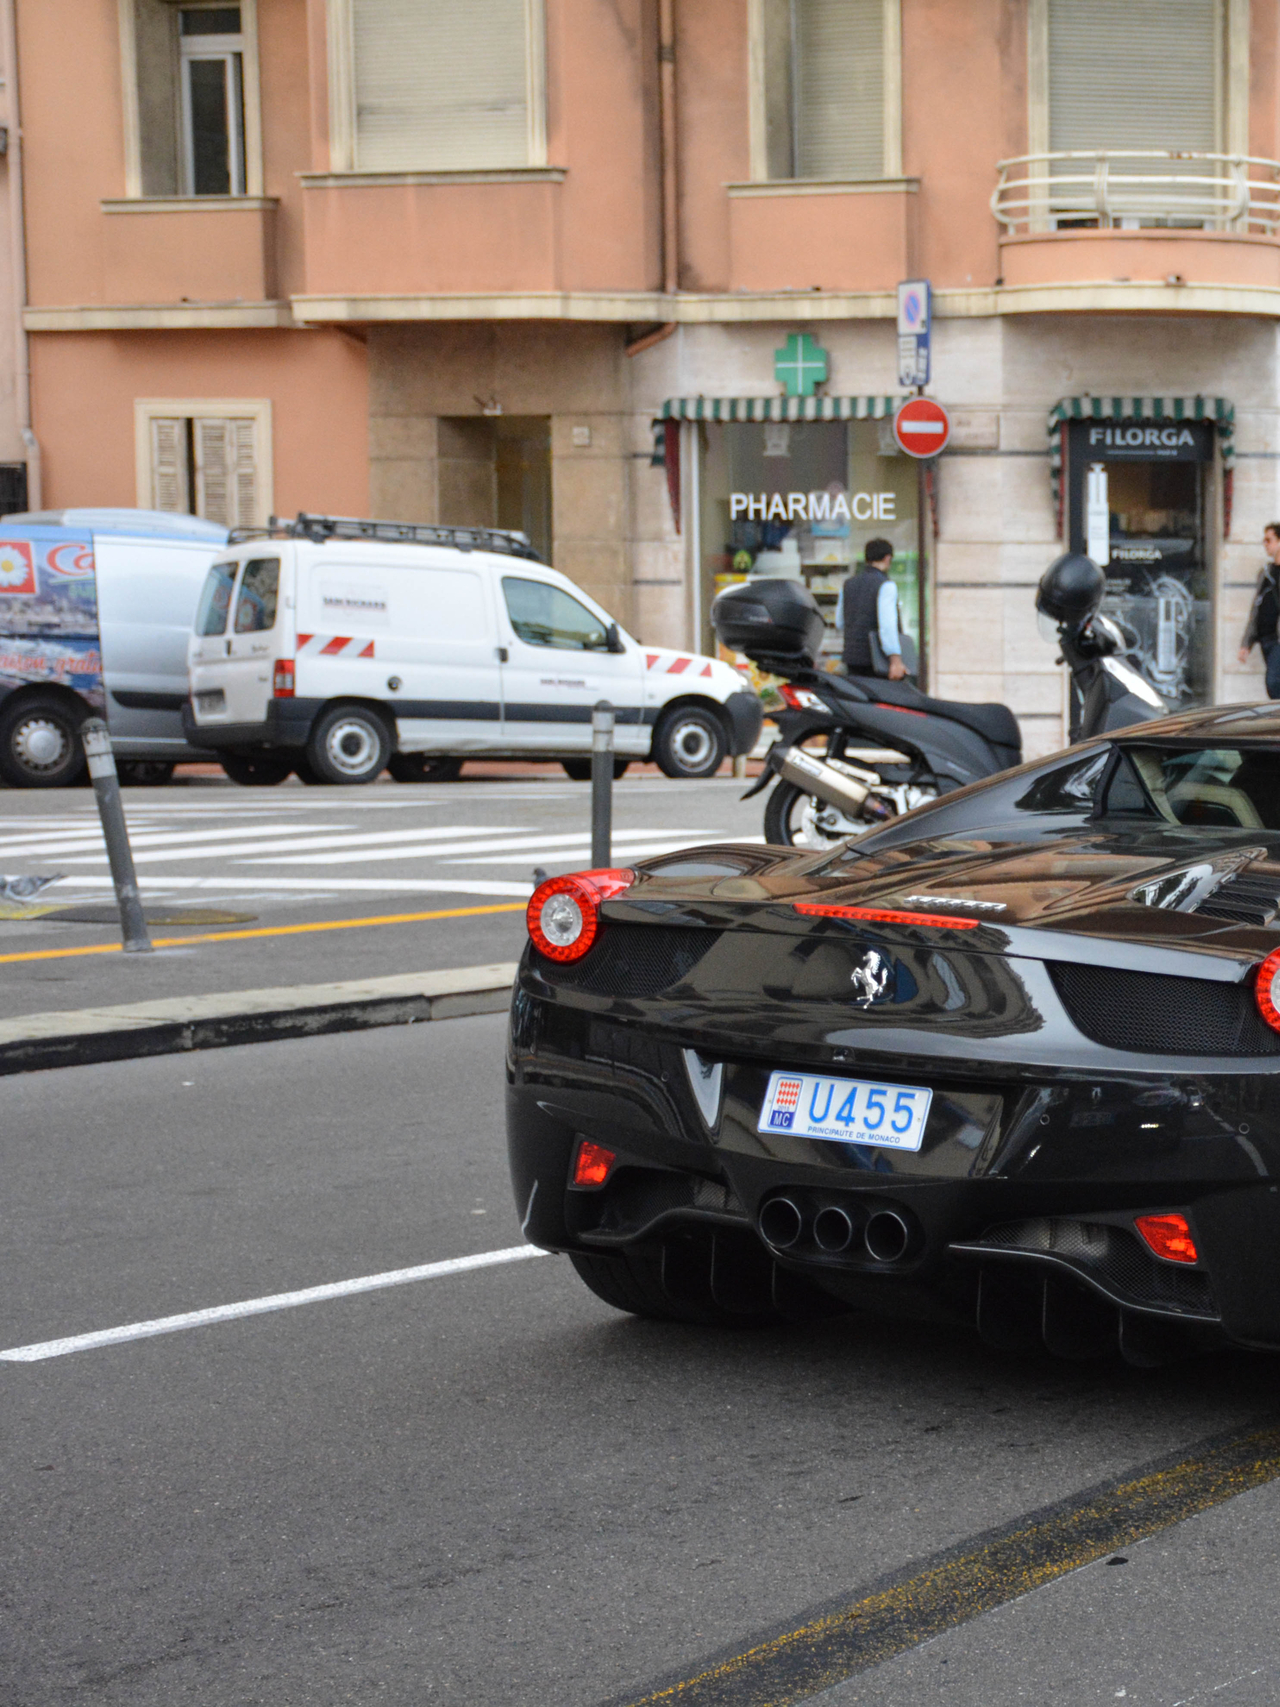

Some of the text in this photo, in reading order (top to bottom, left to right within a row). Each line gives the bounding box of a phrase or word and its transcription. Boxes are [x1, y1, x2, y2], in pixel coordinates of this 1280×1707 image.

[1089, 428, 1194, 446] FILORGA
[730, 492, 896, 521] PHARMACIE
[1112, 548, 1162, 560] FILORGA
[774, 1082, 916, 1133] MC U455
[807, 1125, 901, 1144] PRINCIPAUTE DE MONACO
